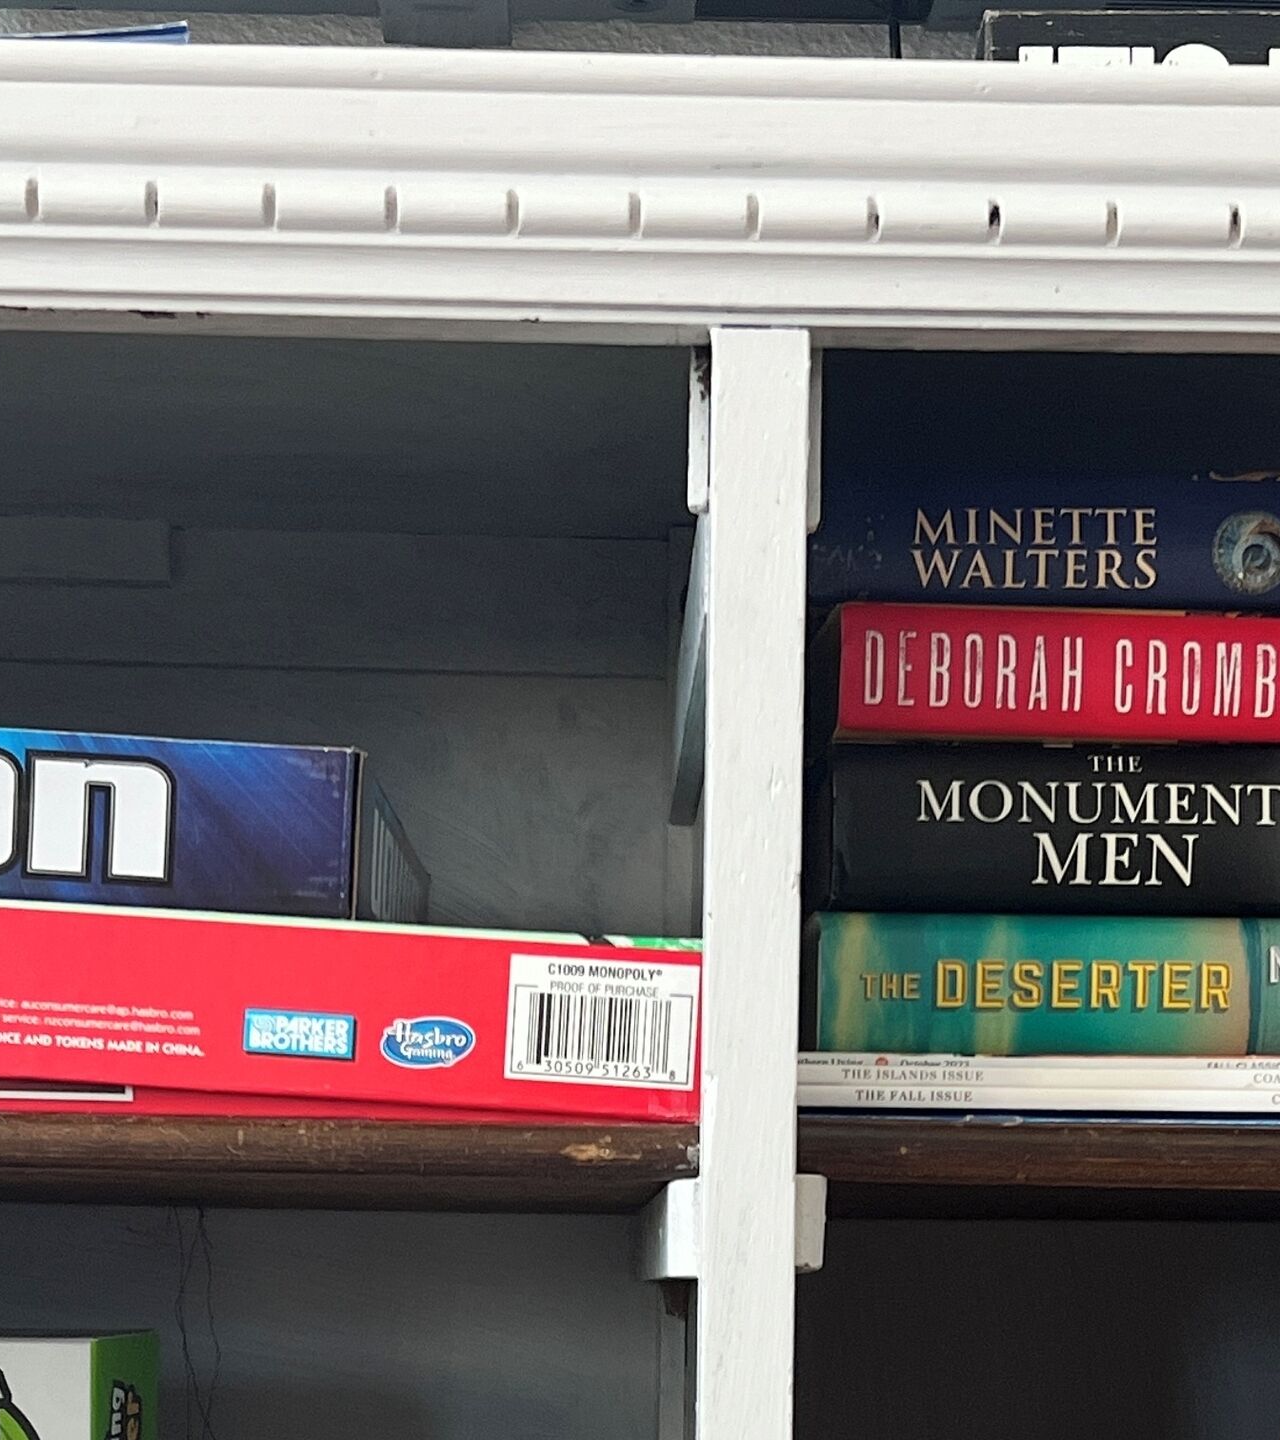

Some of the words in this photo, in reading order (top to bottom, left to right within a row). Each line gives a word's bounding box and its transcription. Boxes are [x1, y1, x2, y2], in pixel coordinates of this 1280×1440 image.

[912, 506, 1159, 549] MINETTE
[914, 547, 1159, 591] WALTERS
[863, 627, 1084, 714] DEBORAH
[1088, 754, 1144, 774] THE
[1031, 832, 1198, 887] MEN
[548, 963, 585, 977] C1009
[861, 972, 922, 1000] THE
[935, 959, 1232, 1011] DESERTER
[276, 1014, 349, 1037] PARKER
[387, 1021, 468, 1048] Hasbro
[248, 1029, 348, 1055] BROTHERS
[841, 1068, 871, 1080] THE
[875, 1068, 938, 1081] ISLANDS
[942, 1069, 984, 1081] ISSUE
[855, 1089, 885, 1101] THE
[889, 1090, 926, 1102] FALL
[929, 1090, 973, 1102] ISSUE
